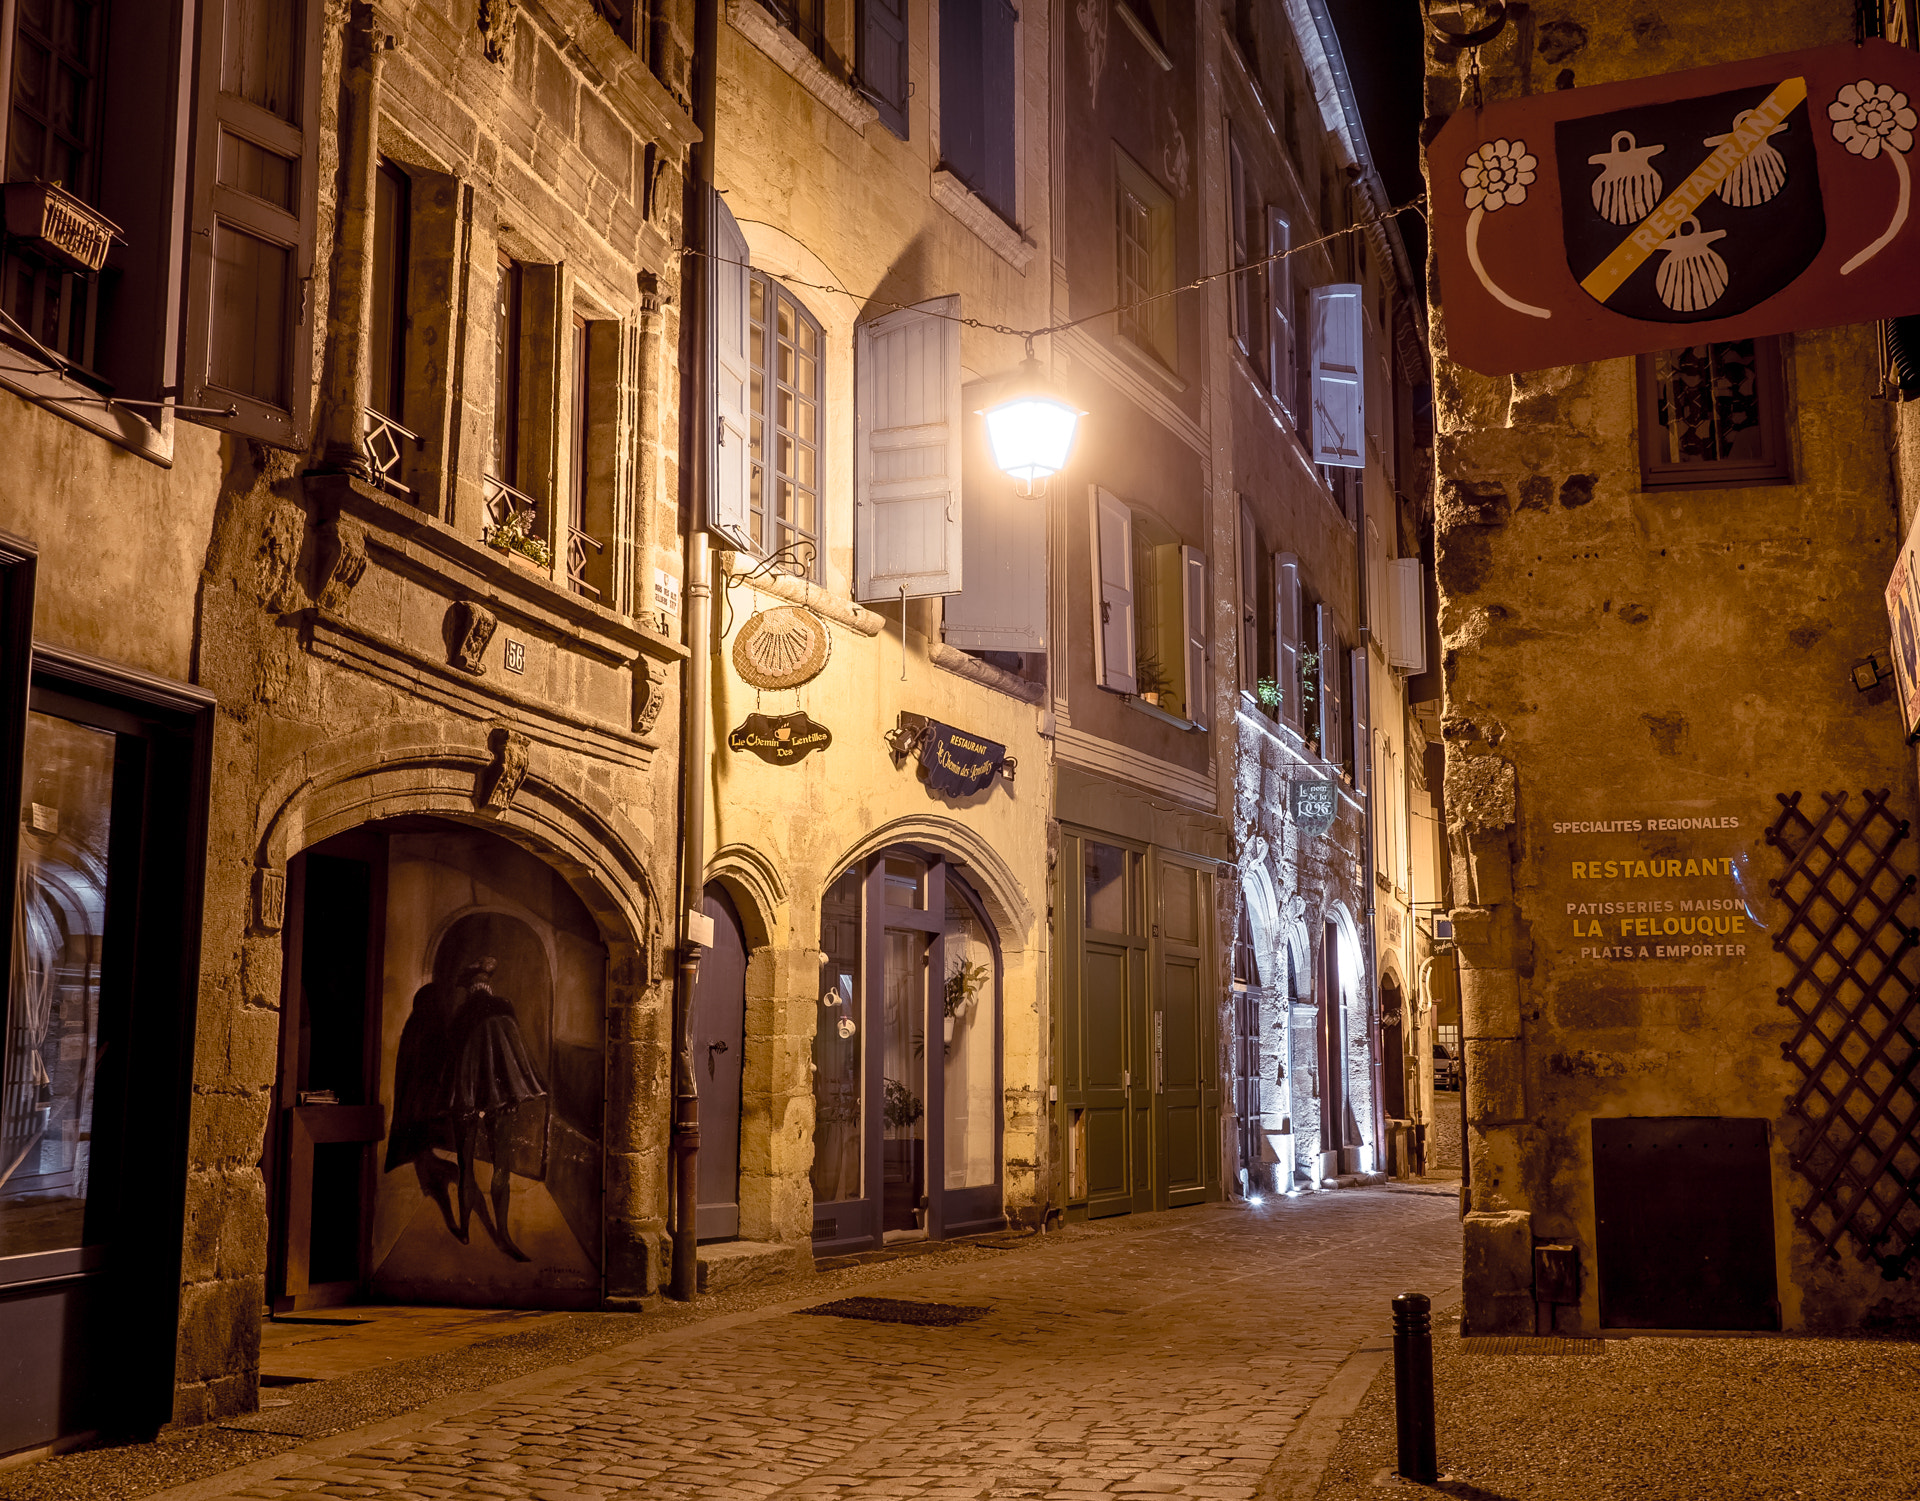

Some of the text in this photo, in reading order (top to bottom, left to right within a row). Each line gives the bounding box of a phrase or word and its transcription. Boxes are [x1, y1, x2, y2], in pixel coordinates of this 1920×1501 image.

[1632, 95, 1786, 252] RESTAURANT
[509, 642, 524, 669] 56
[731, 732, 828, 757] Le Chemin Des Lentilles
[950, 734, 988, 756] RESTAURANT
[943, 751, 961, 775] Chemin
[960, 764, 970, 777] des
[1300, 784, 1308, 798] Le
[1319, 793, 1327, 801] la
[1552, 817, 1739, 833] SPECIALITES REGIONALES
[1571, 857, 1734, 879] RESTAURANT
[1566, 899, 1745, 915] PATISSERIES MAISON
[1573, 915, 1746, 937] LA FELOUQUE
[1581, 944, 1746, 959] PLATS A EMPORTER
